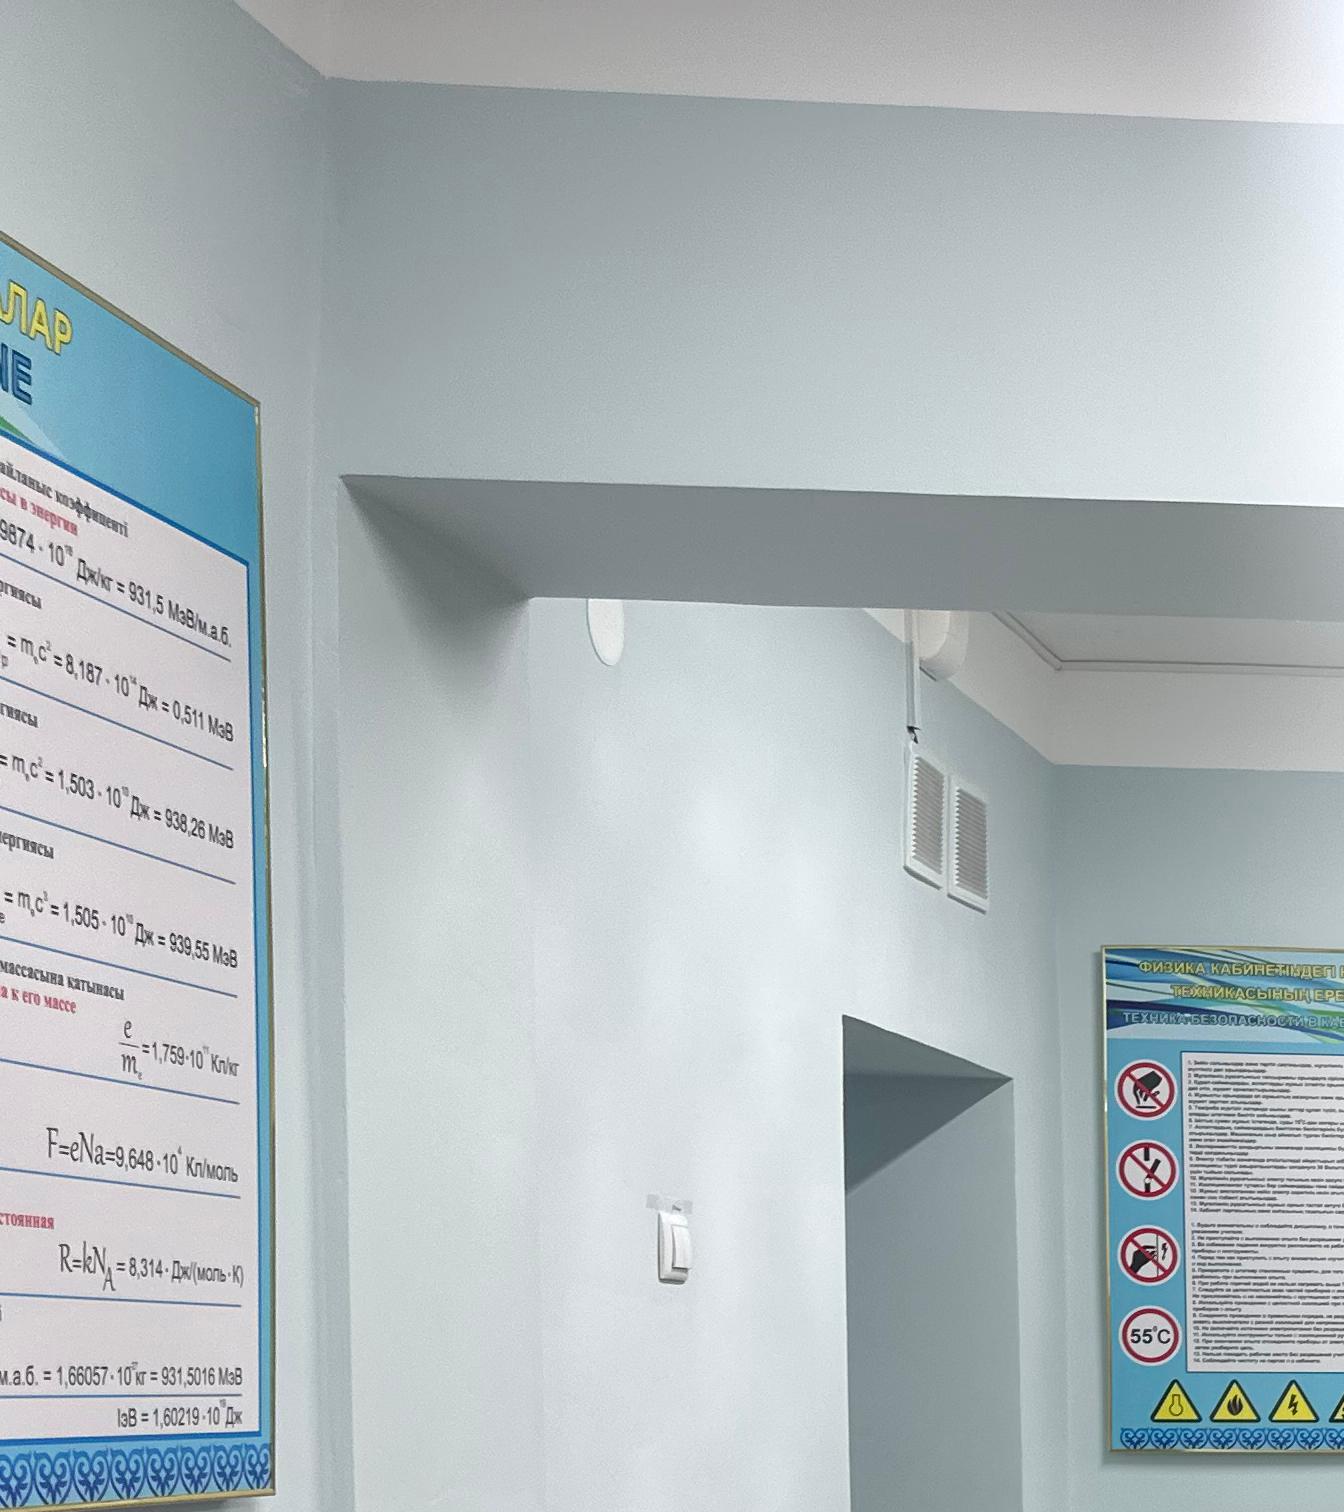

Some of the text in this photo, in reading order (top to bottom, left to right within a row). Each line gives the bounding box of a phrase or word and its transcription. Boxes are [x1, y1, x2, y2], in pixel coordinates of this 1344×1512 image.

[129, 581, 164, 615] 931,5
[65, 653, 234, 742] 8,187 Дж 0,511 МэВ
[58, 769, 234, 849] 1,503 Дж 938,26 МэВ
[63, 901, 238, 968] 1,505 Дж 939,55 МэВ
[1138, 960, 1205, 975] ФИЗИКА
[1123, 1012, 1186, 1025] ТЕХНИКА
[1191, 1013, 1305, 1028] БЕЗОПАСНОСТИ
